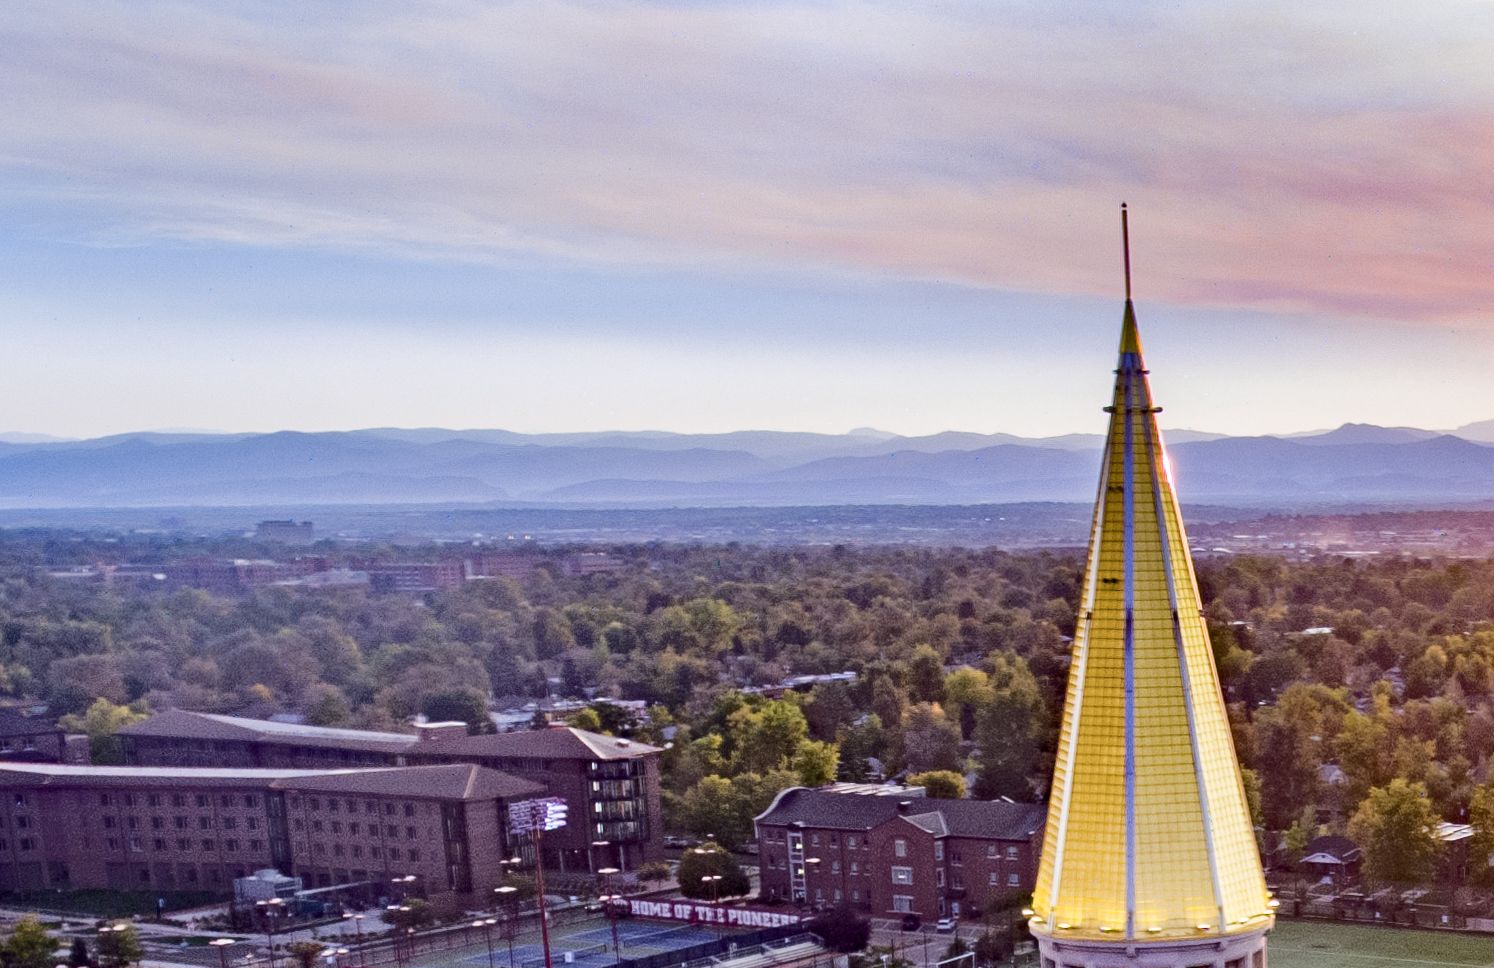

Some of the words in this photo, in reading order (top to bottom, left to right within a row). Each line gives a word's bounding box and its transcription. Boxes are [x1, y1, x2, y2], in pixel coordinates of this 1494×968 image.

[630, 900, 672, 918] HOME
[674, 904, 692, 919] OF
[695, 906, 724, 923] THE
[728, 909, 799, 928] PIONEERS
